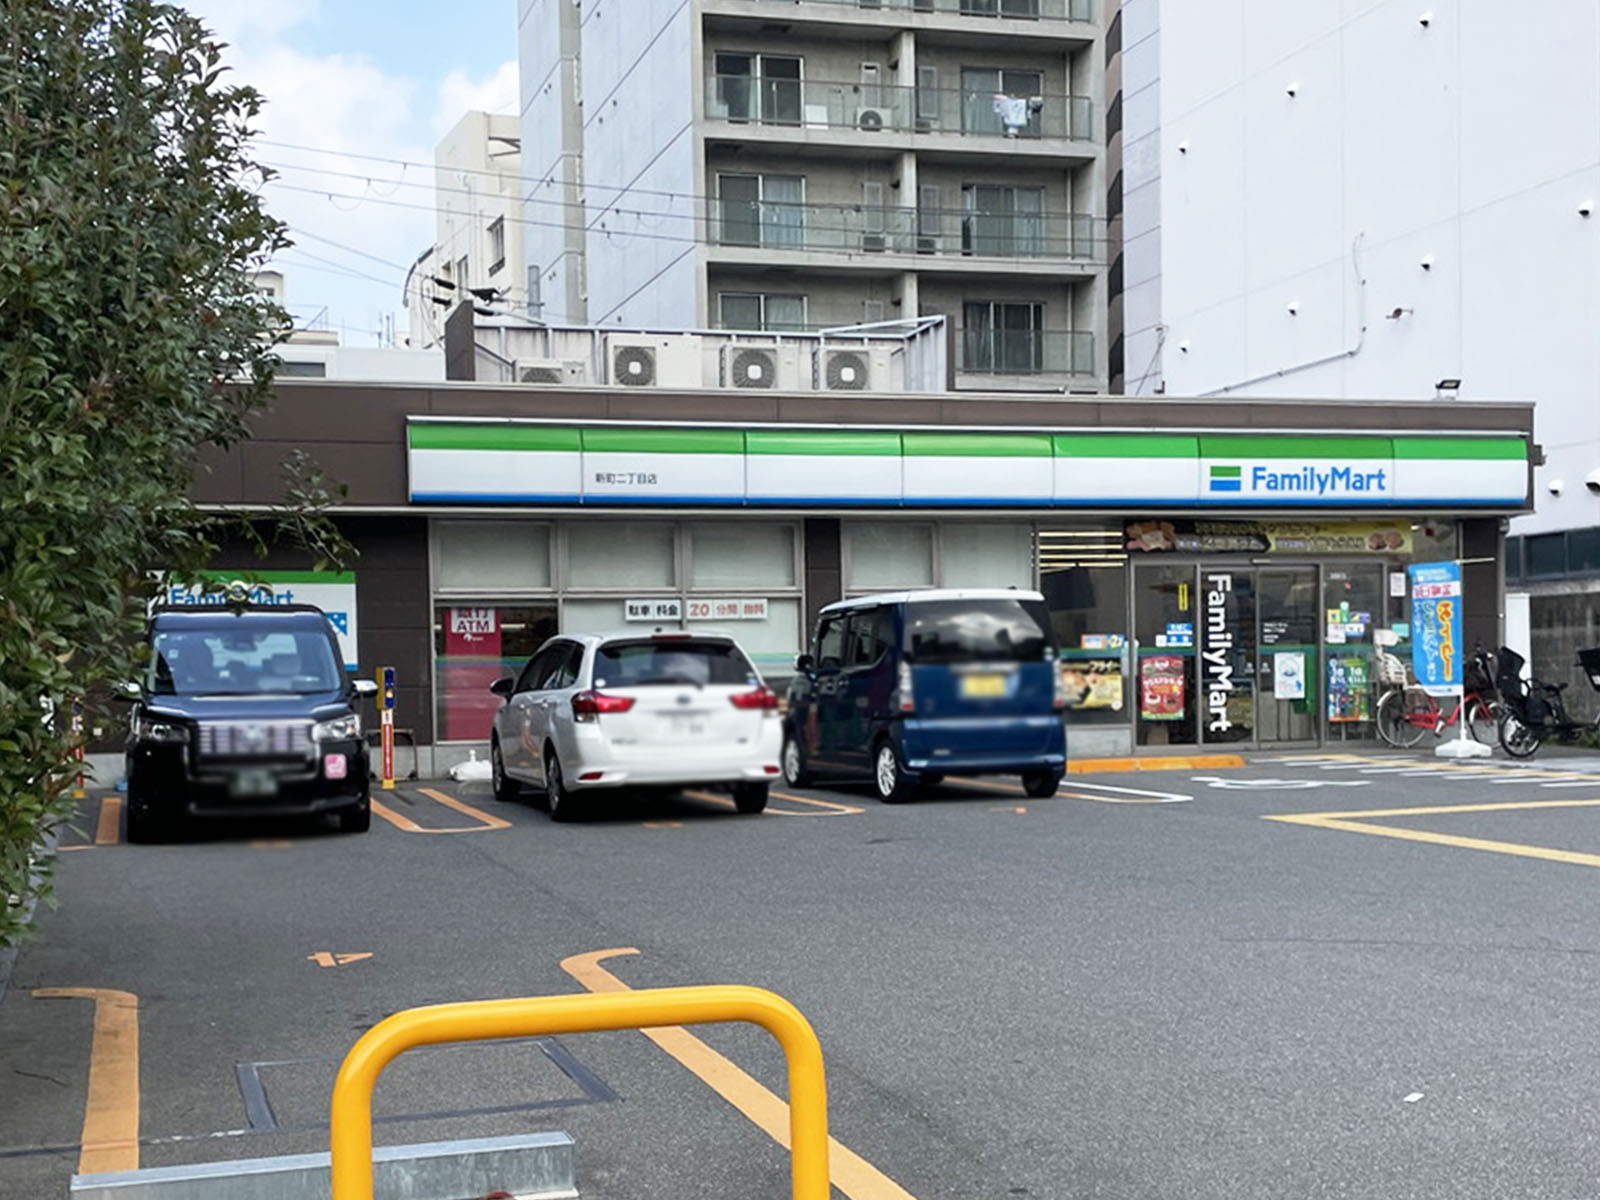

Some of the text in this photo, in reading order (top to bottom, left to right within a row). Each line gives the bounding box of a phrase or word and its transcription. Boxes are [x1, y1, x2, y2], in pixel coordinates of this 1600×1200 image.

[595, 472, 658, 485] 新町二丁目店
[1252, 466, 1386, 494] FamilyMart
[456, 620, 490, 632] ATM
[1202, 574, 1233, 732] FamilyMart
